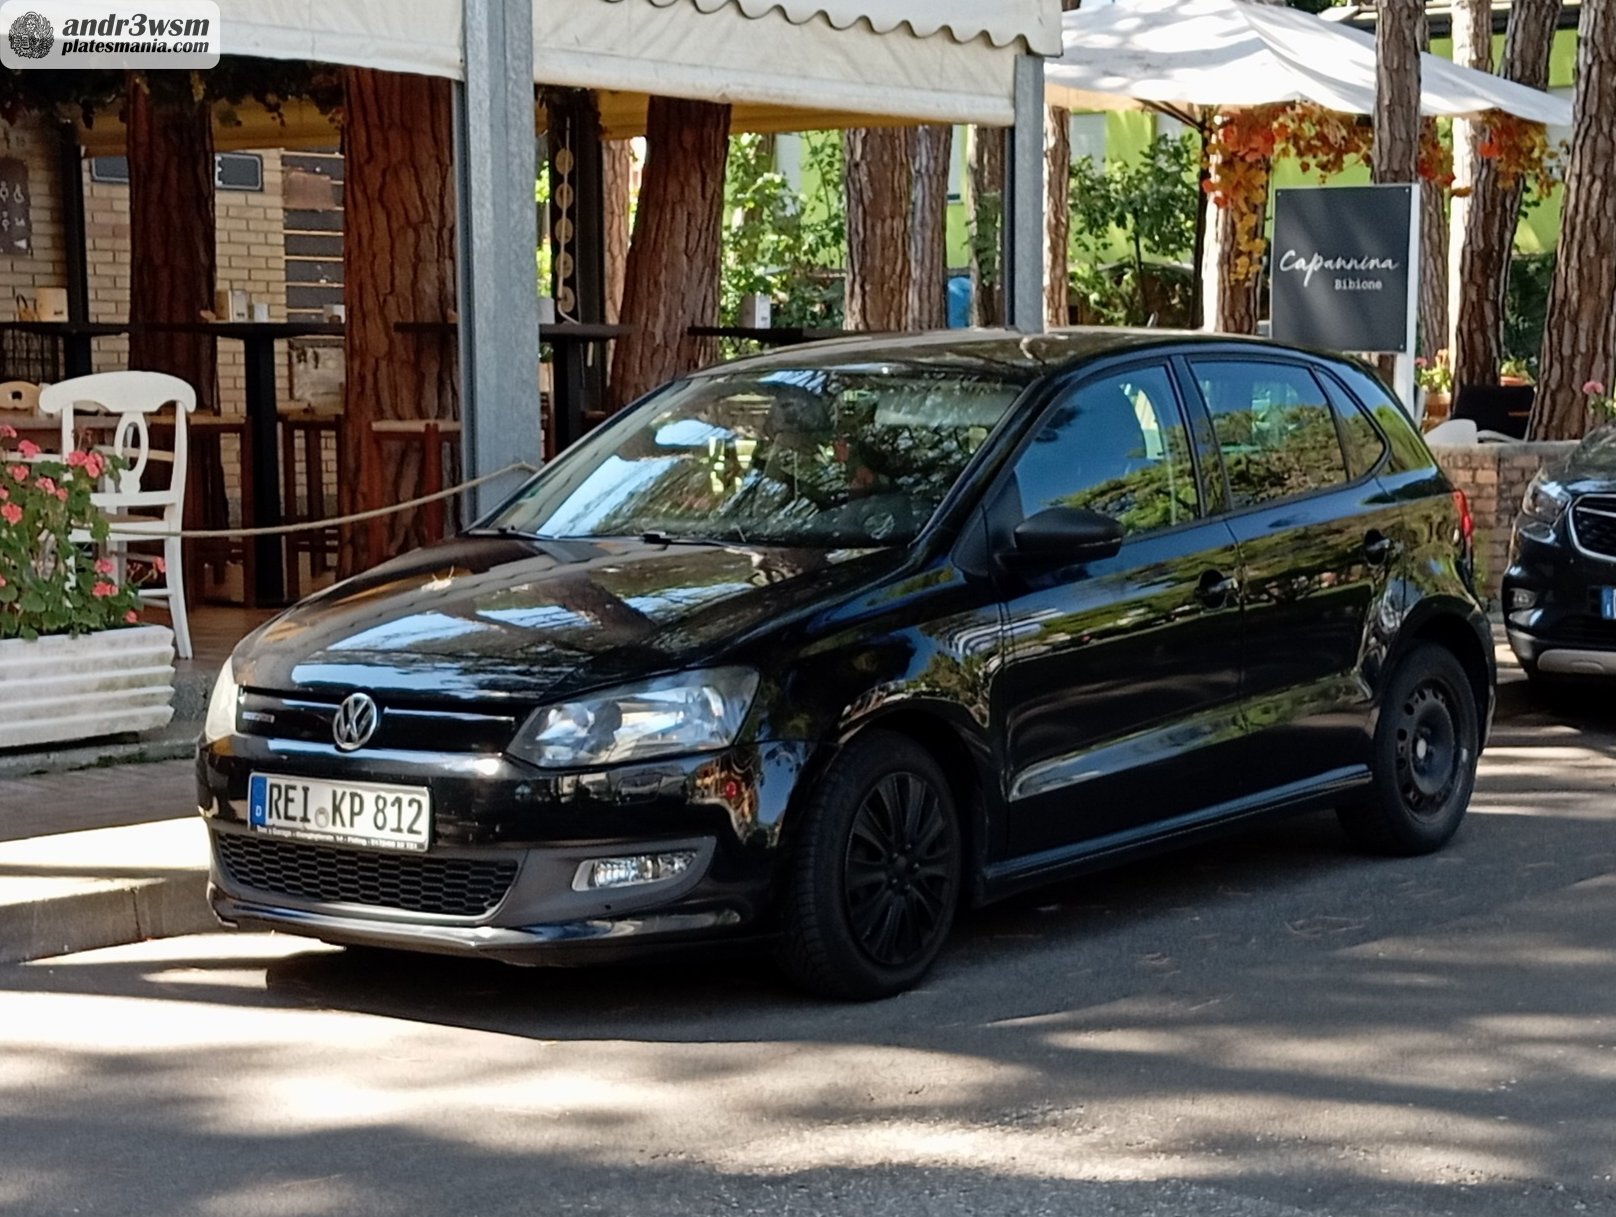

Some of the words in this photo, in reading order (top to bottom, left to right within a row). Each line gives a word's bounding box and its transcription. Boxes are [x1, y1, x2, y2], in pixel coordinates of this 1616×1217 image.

[1279, 249, 1399, 288] Capannina
[1334, 278, 1383, 291] Bibione
[255, 805, 262, 817] D
[268, 782, 311, 824] REI
[331, 789, 364, 828] KP
[373, 794, 422, 835] 812
